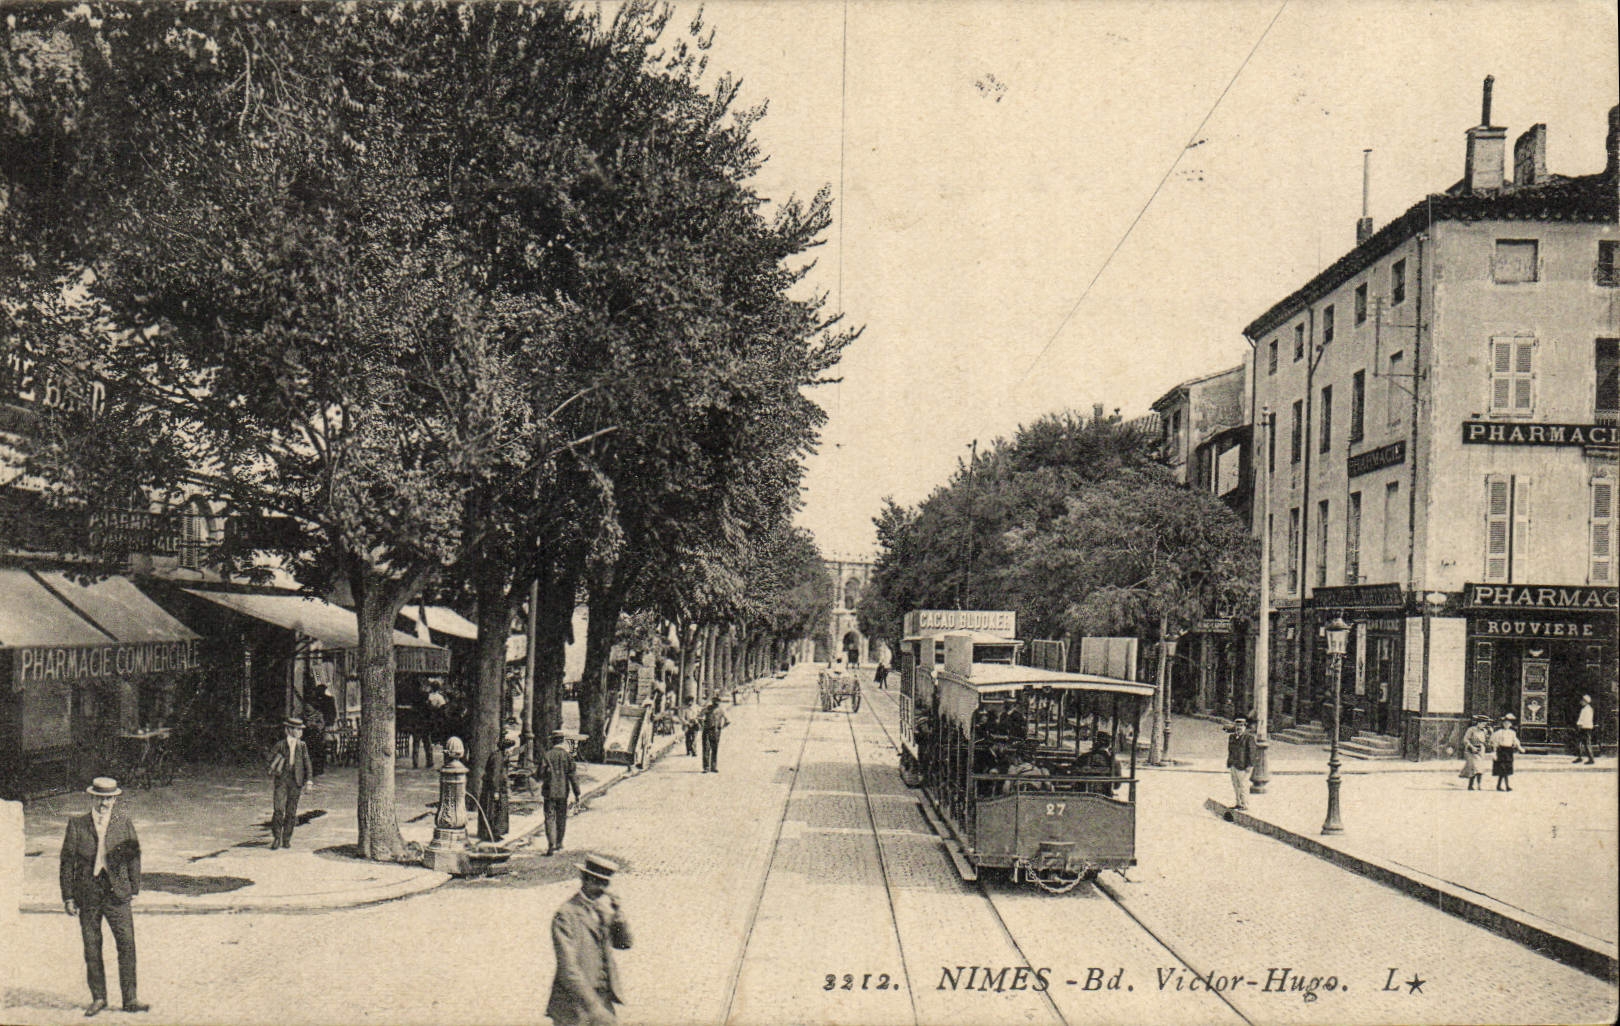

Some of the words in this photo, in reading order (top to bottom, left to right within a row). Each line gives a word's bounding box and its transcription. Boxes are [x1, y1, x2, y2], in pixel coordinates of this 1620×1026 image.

[920, 612, 955, 629] CACAO
[1487, 620, 1594, 636] ROUVIERE
[21, 647, 113, 682] PHARMACIE
[115, 640, 201, 676] COMMERCIALE
[1046, 803, 1066, 817] 27
